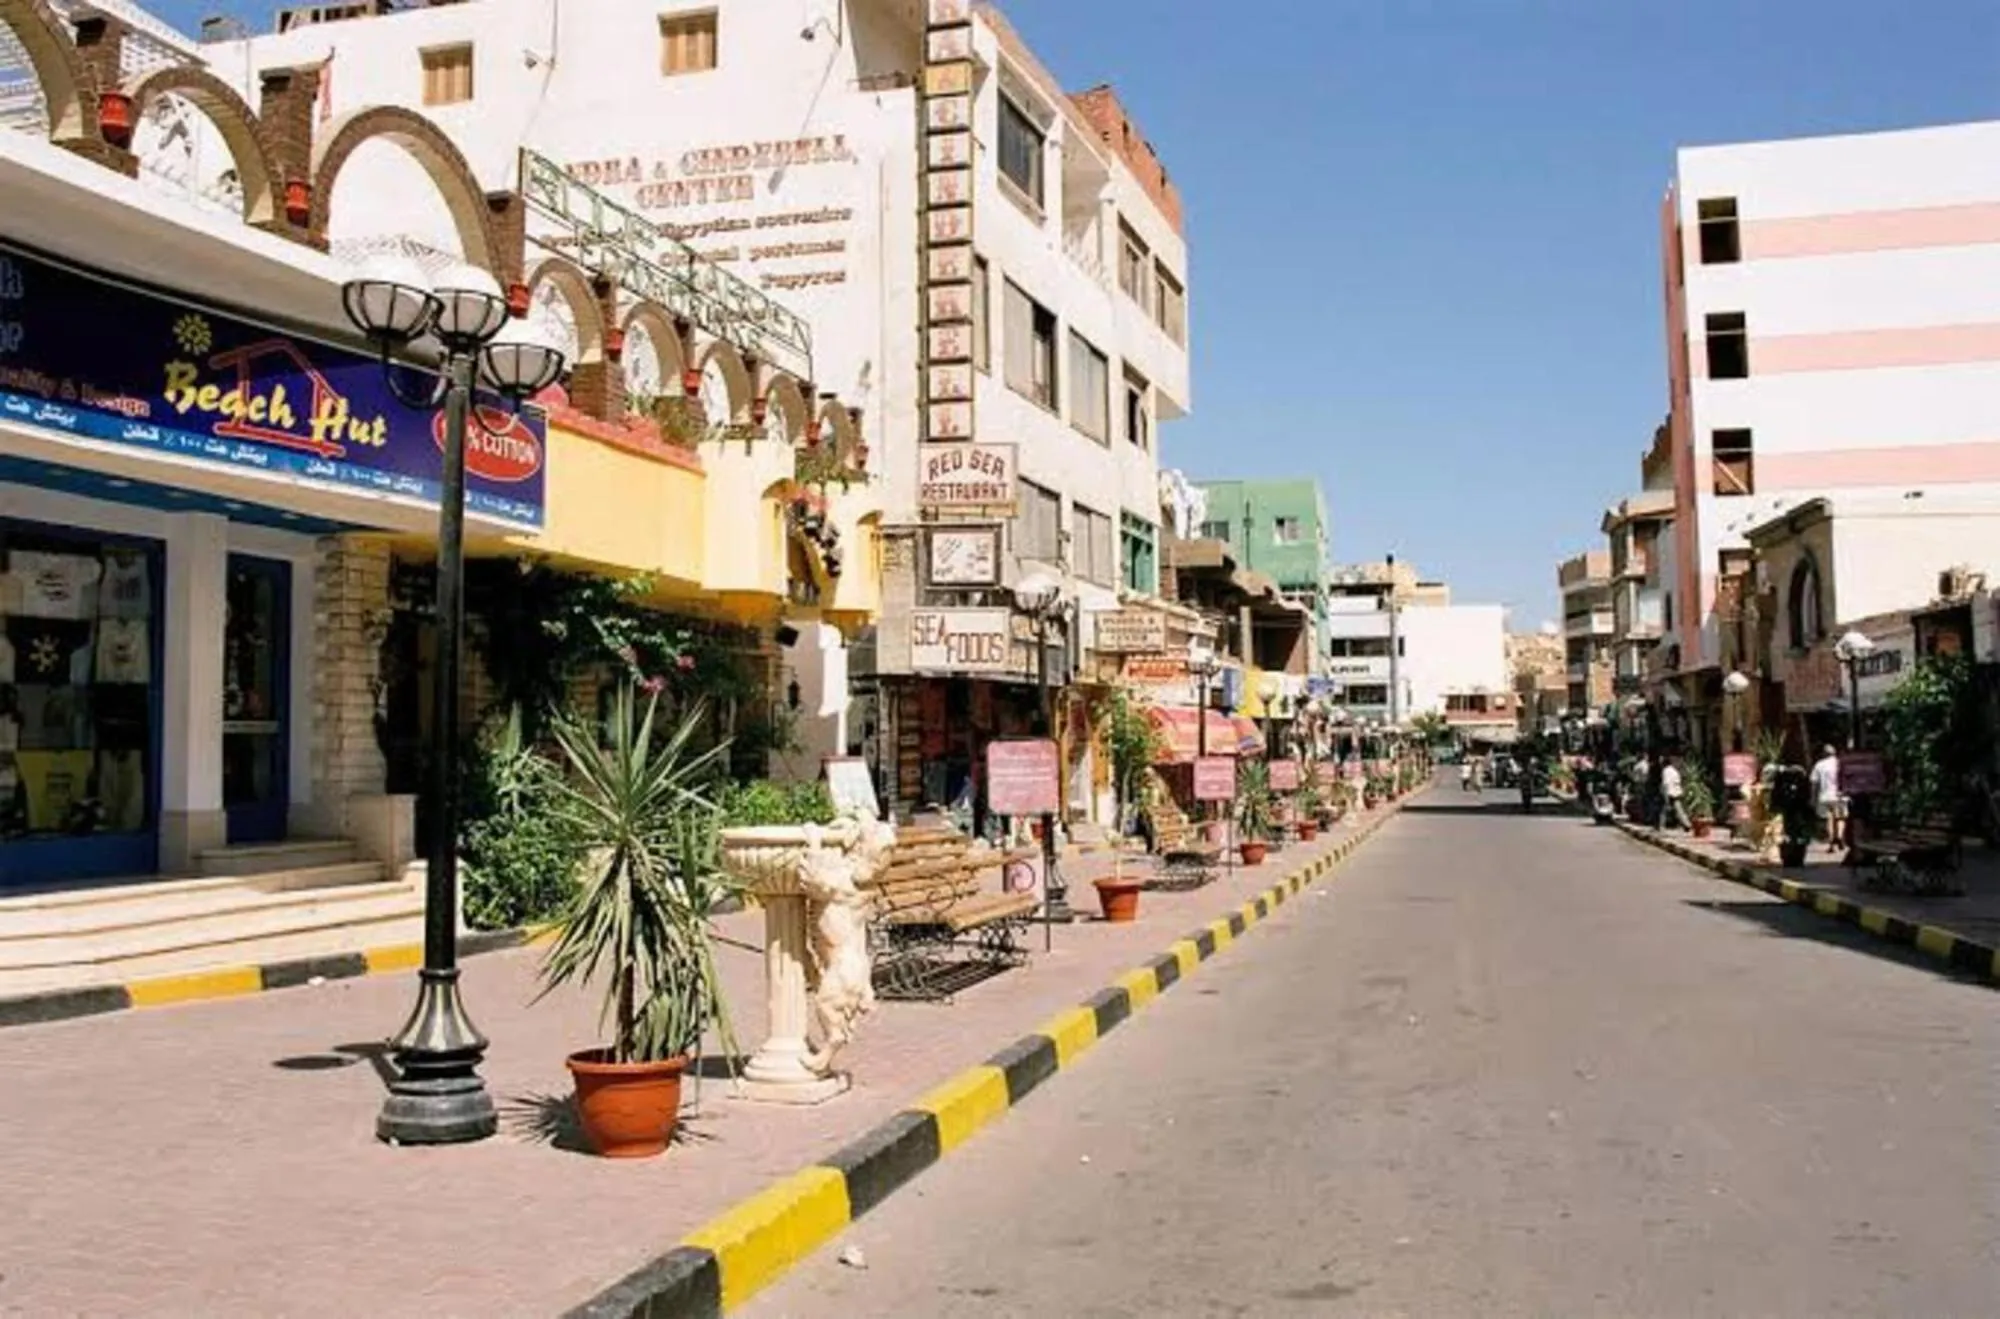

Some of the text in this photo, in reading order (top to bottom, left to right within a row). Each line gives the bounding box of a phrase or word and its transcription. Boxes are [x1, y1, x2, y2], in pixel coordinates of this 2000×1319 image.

[163, 358, 388, 447] Beach Hut
[928, 448, 1005, 482] RED SEA
[921, 481, 1008, 501] RESTAURANT
[914, 614, 946, 646] SEA
[944, 632, 1004, 664] FOODS
